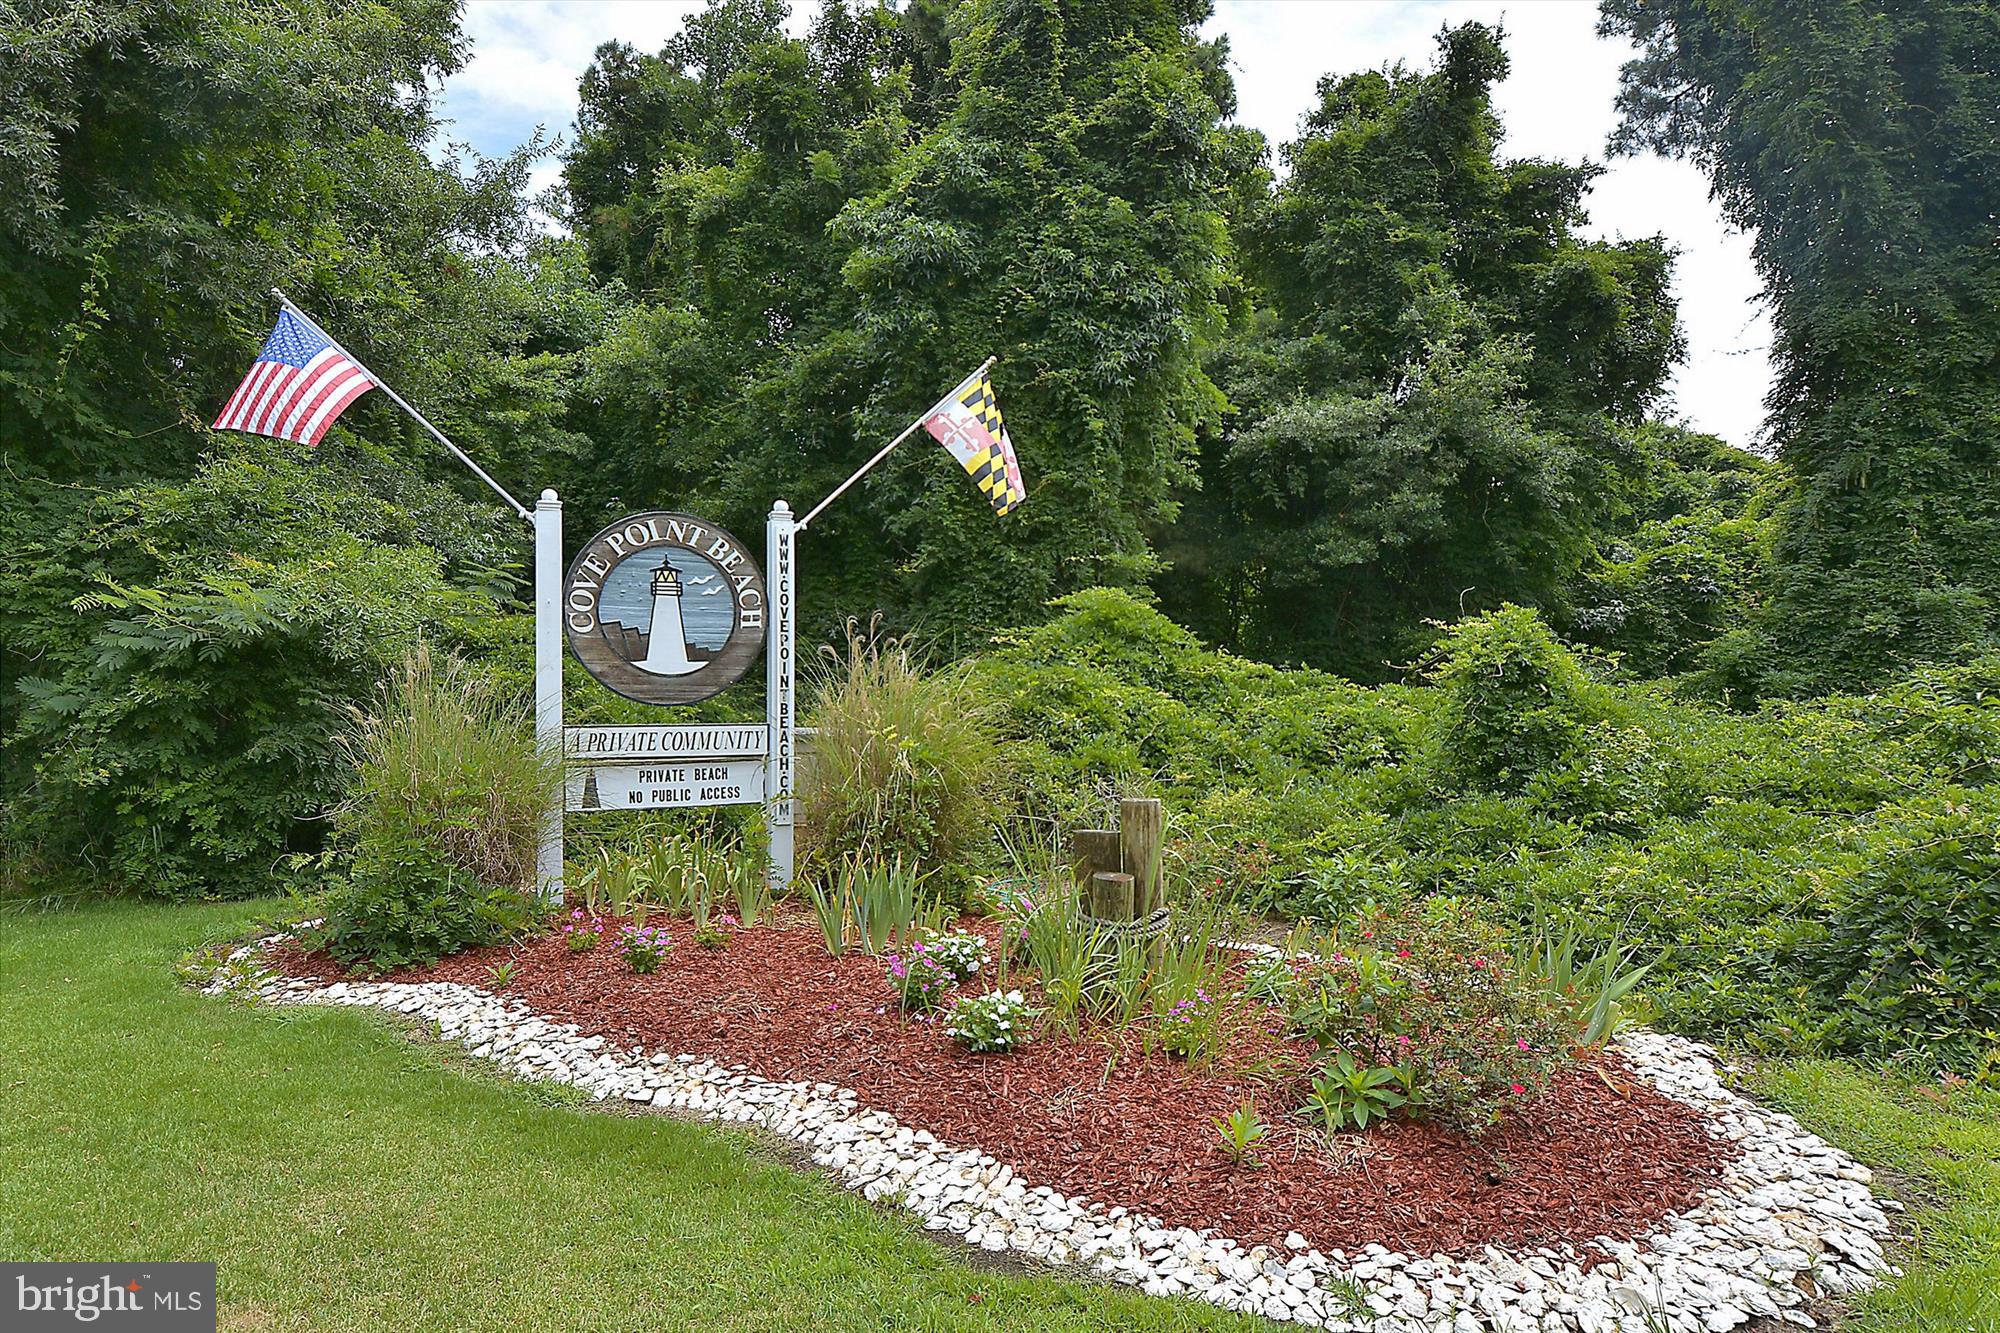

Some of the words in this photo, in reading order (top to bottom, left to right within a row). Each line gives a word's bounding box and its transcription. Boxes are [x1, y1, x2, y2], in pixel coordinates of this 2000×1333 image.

[569, 553, 612, 633] COVE
[603, 519, 709, 558] POINT
[704, 536, 763, 629] BEACH
[566, 731, 581, 752] A
[587, 731, 658, 752] PRIVATE
[661, 730, 764, 751] COMMUNITY
[639, 769, 685, 783] PRIVATE
[694, 767, 728, 781] BEACH
[629, 791, 643, 803] NO
[652, 788, 691, 802] PUBLIC
[700, 786, 740, 800] ACCESS
